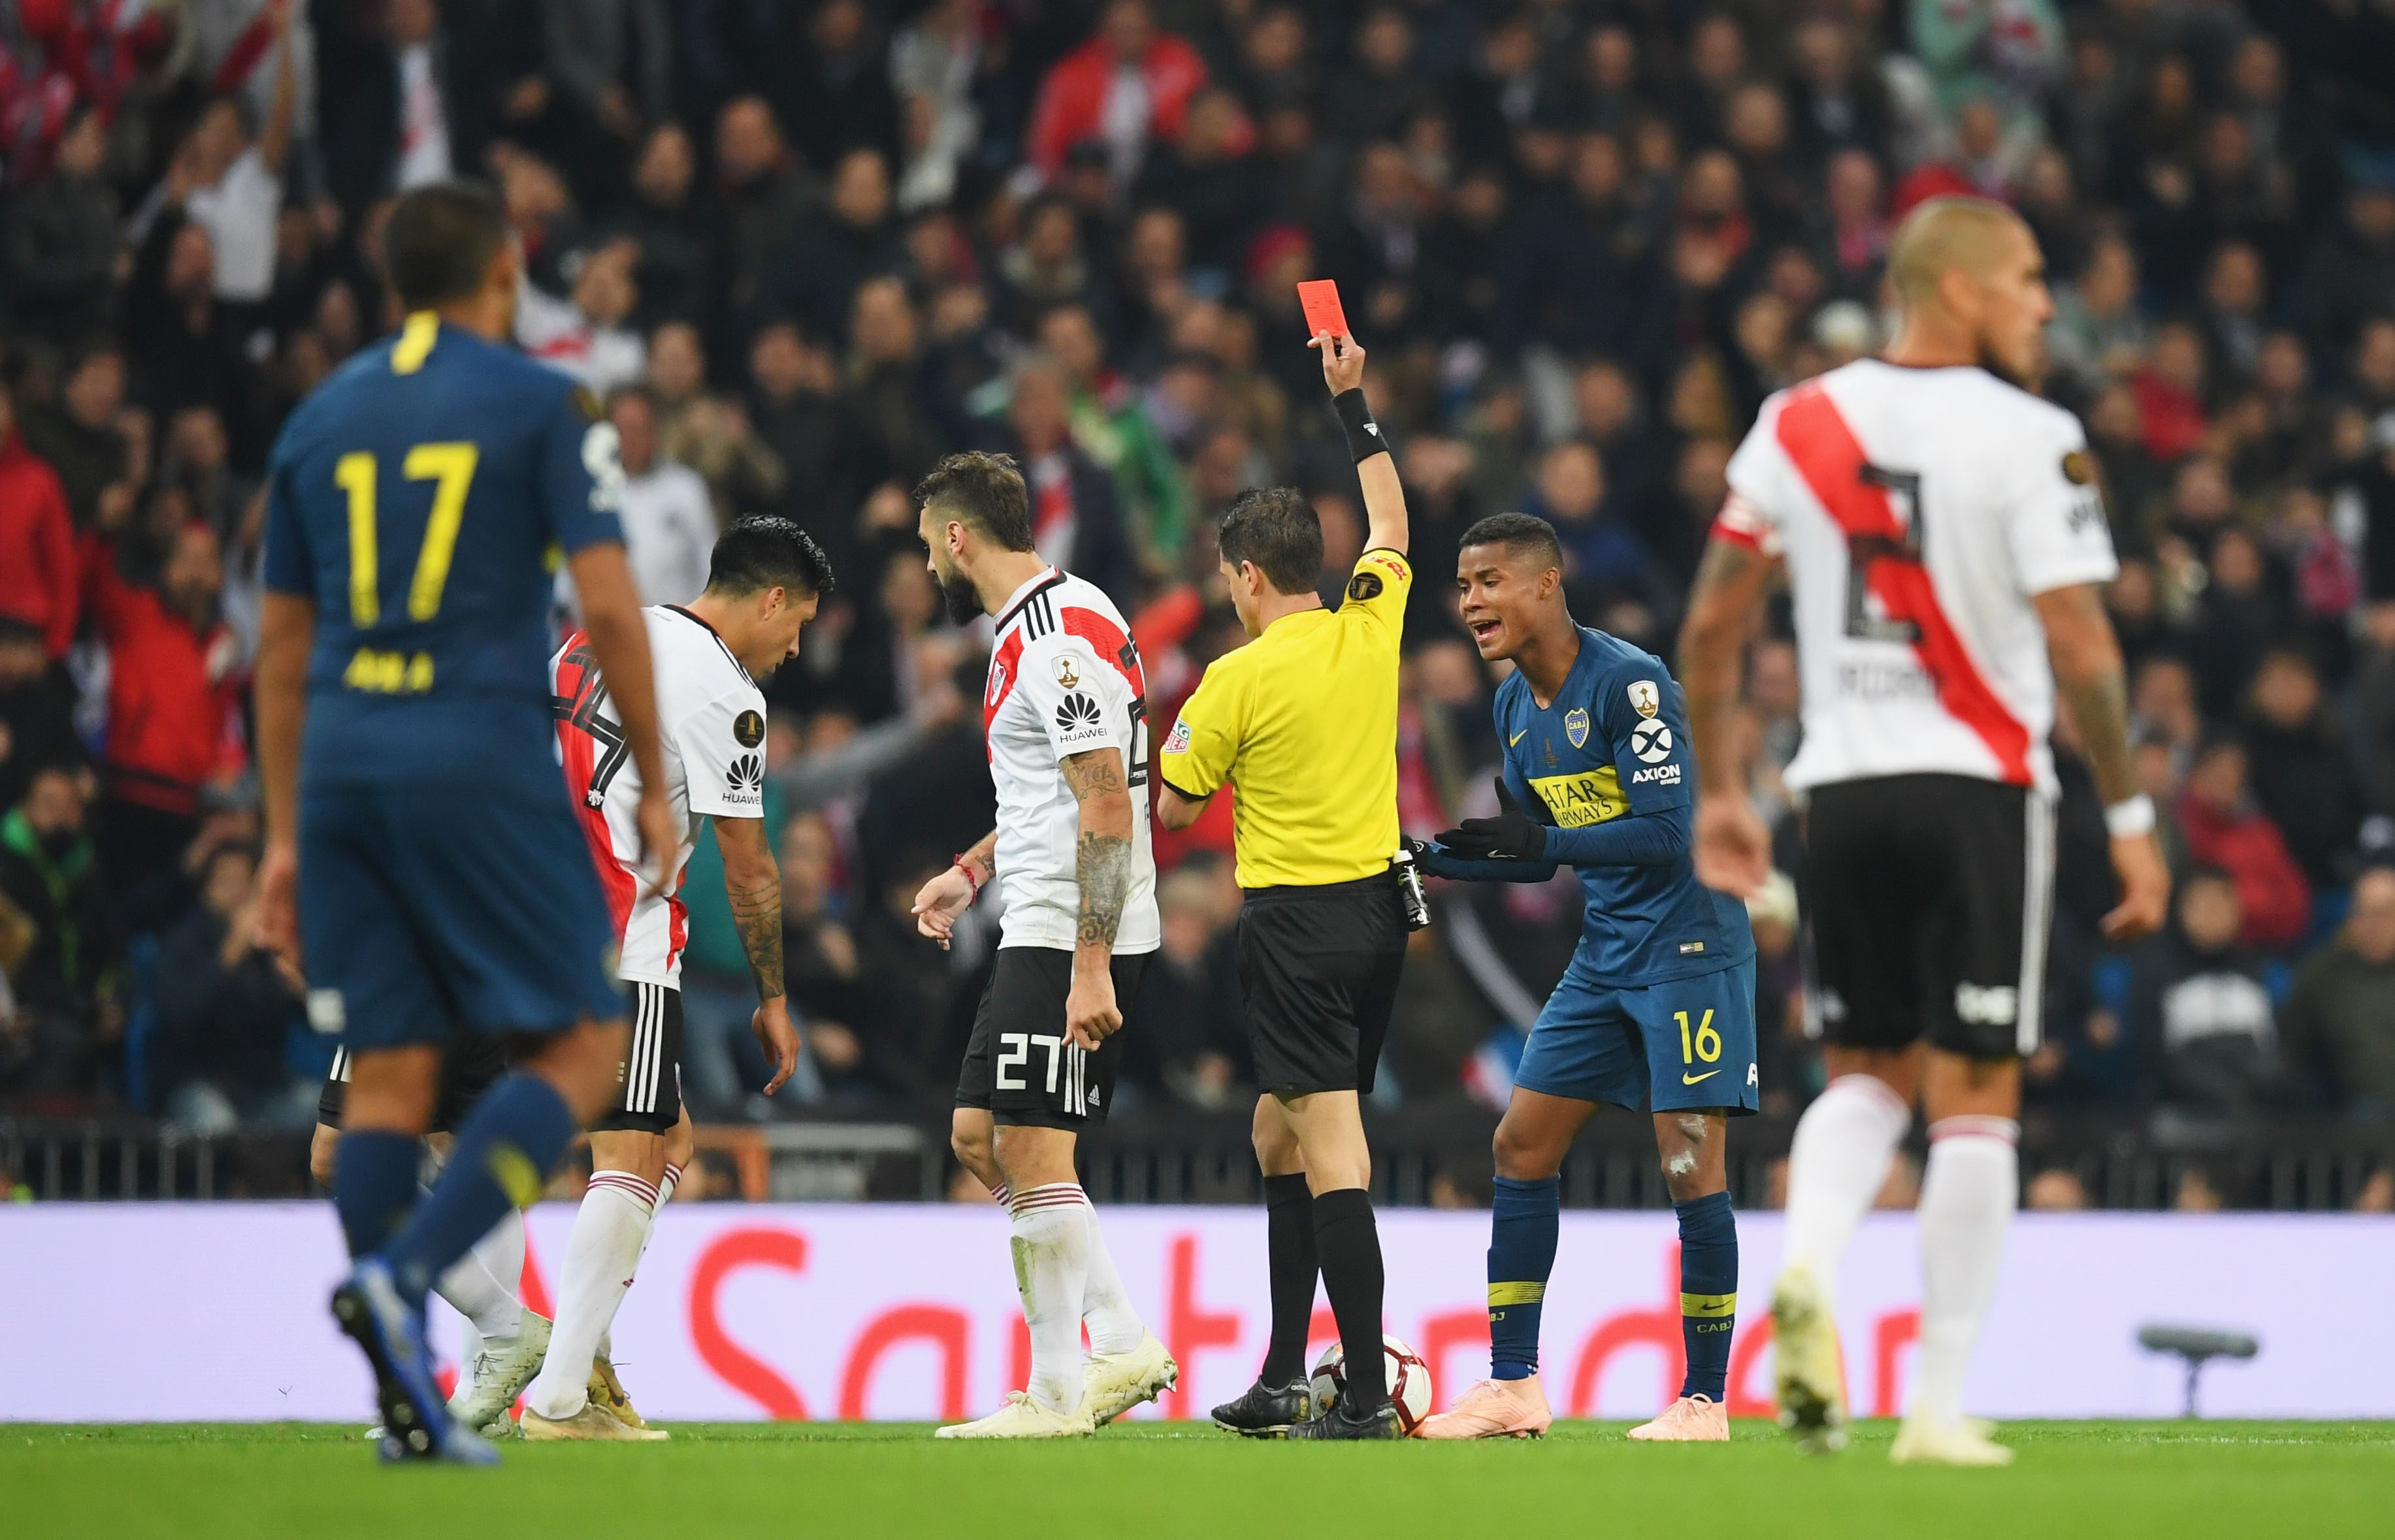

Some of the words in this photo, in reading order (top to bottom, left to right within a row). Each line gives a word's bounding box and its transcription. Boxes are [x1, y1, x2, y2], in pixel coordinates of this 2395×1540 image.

[333, 440, 478, 630] 17
[1060, 727, 1108, 743] HUAWEI
[1568, 720, 1586, 730] CABJ
[1632, 763, 1681, 784] AXION
[722, 792, 760, 805] HUAWE
[1543, 779, 1605, 809] ATAR
[1673, 1008, 1721, 1065] 16
[996, 1033, 1061, 1093] 27
[689, 1227, 1922, 1422] Satnder
[1490, 1311, 1505, 1322] BJ
[1697, 1320, 1732, 1333] CABJ
